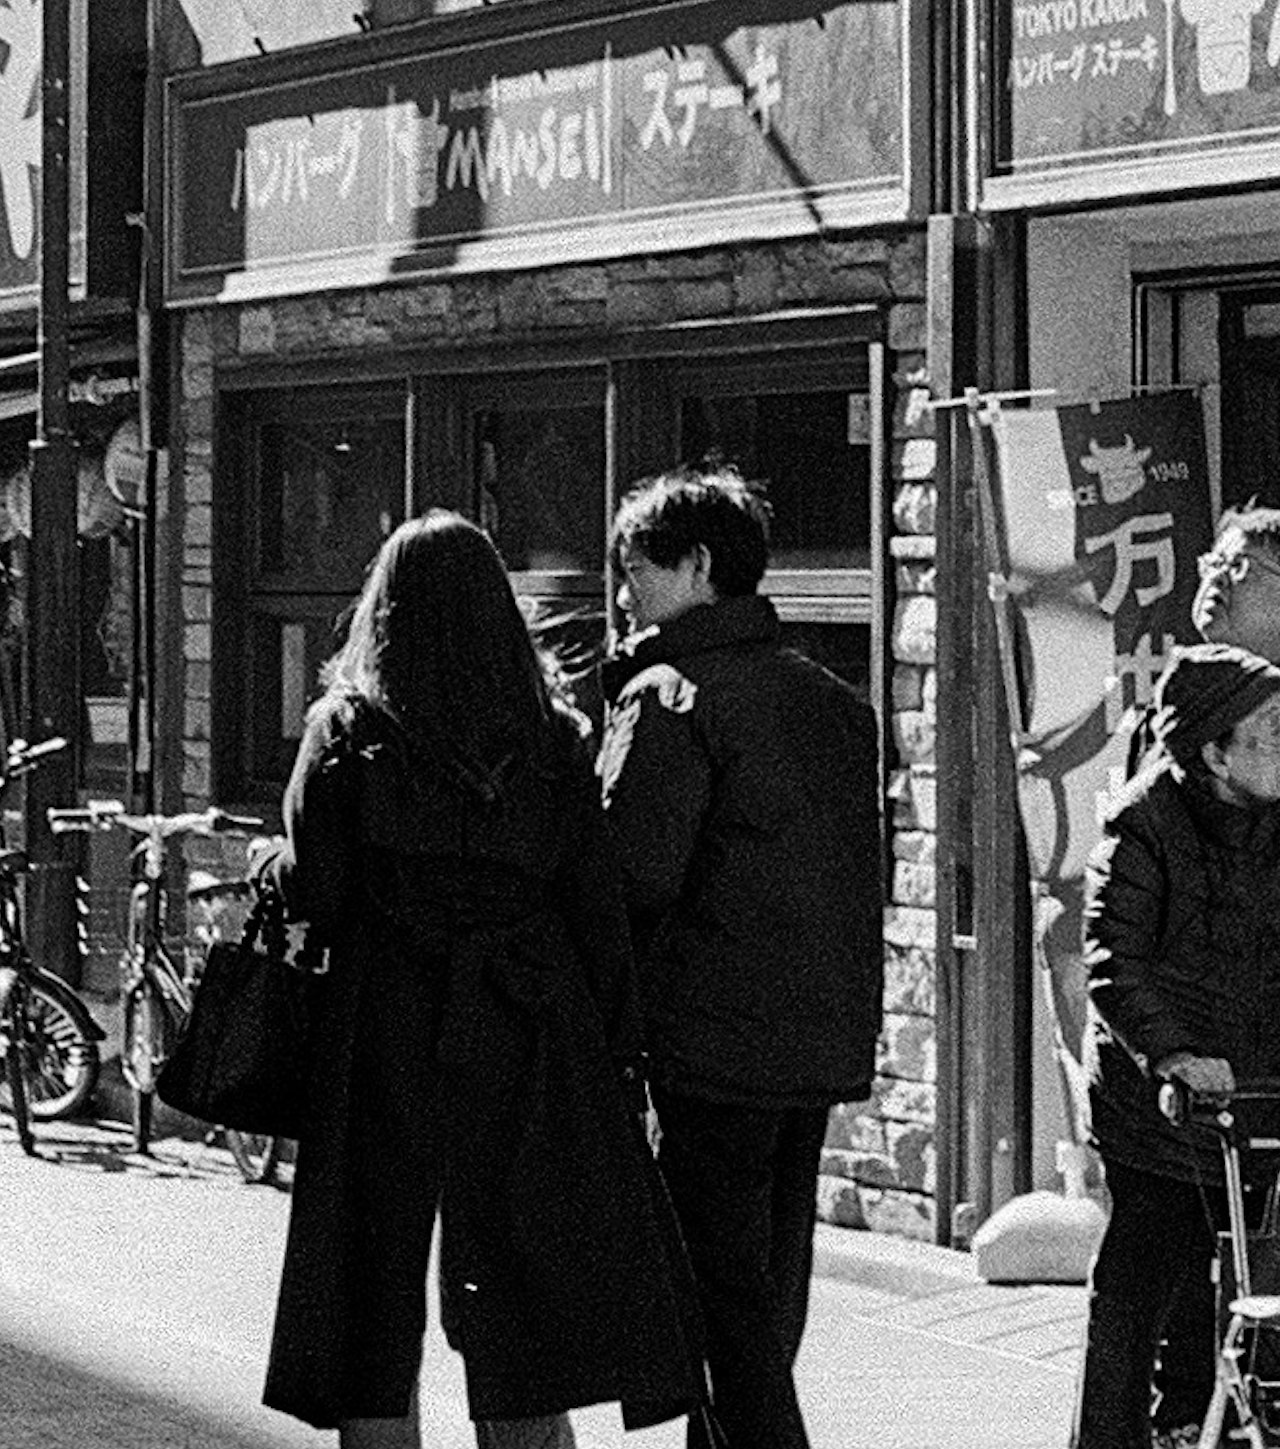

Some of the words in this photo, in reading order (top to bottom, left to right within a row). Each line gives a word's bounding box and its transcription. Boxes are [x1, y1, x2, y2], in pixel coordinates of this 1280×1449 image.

[639, 42, 783, 152] ステーキ
[1091, 33, 1159, 79] ステーキ
[445, 107, 601, 203] MANSEI
